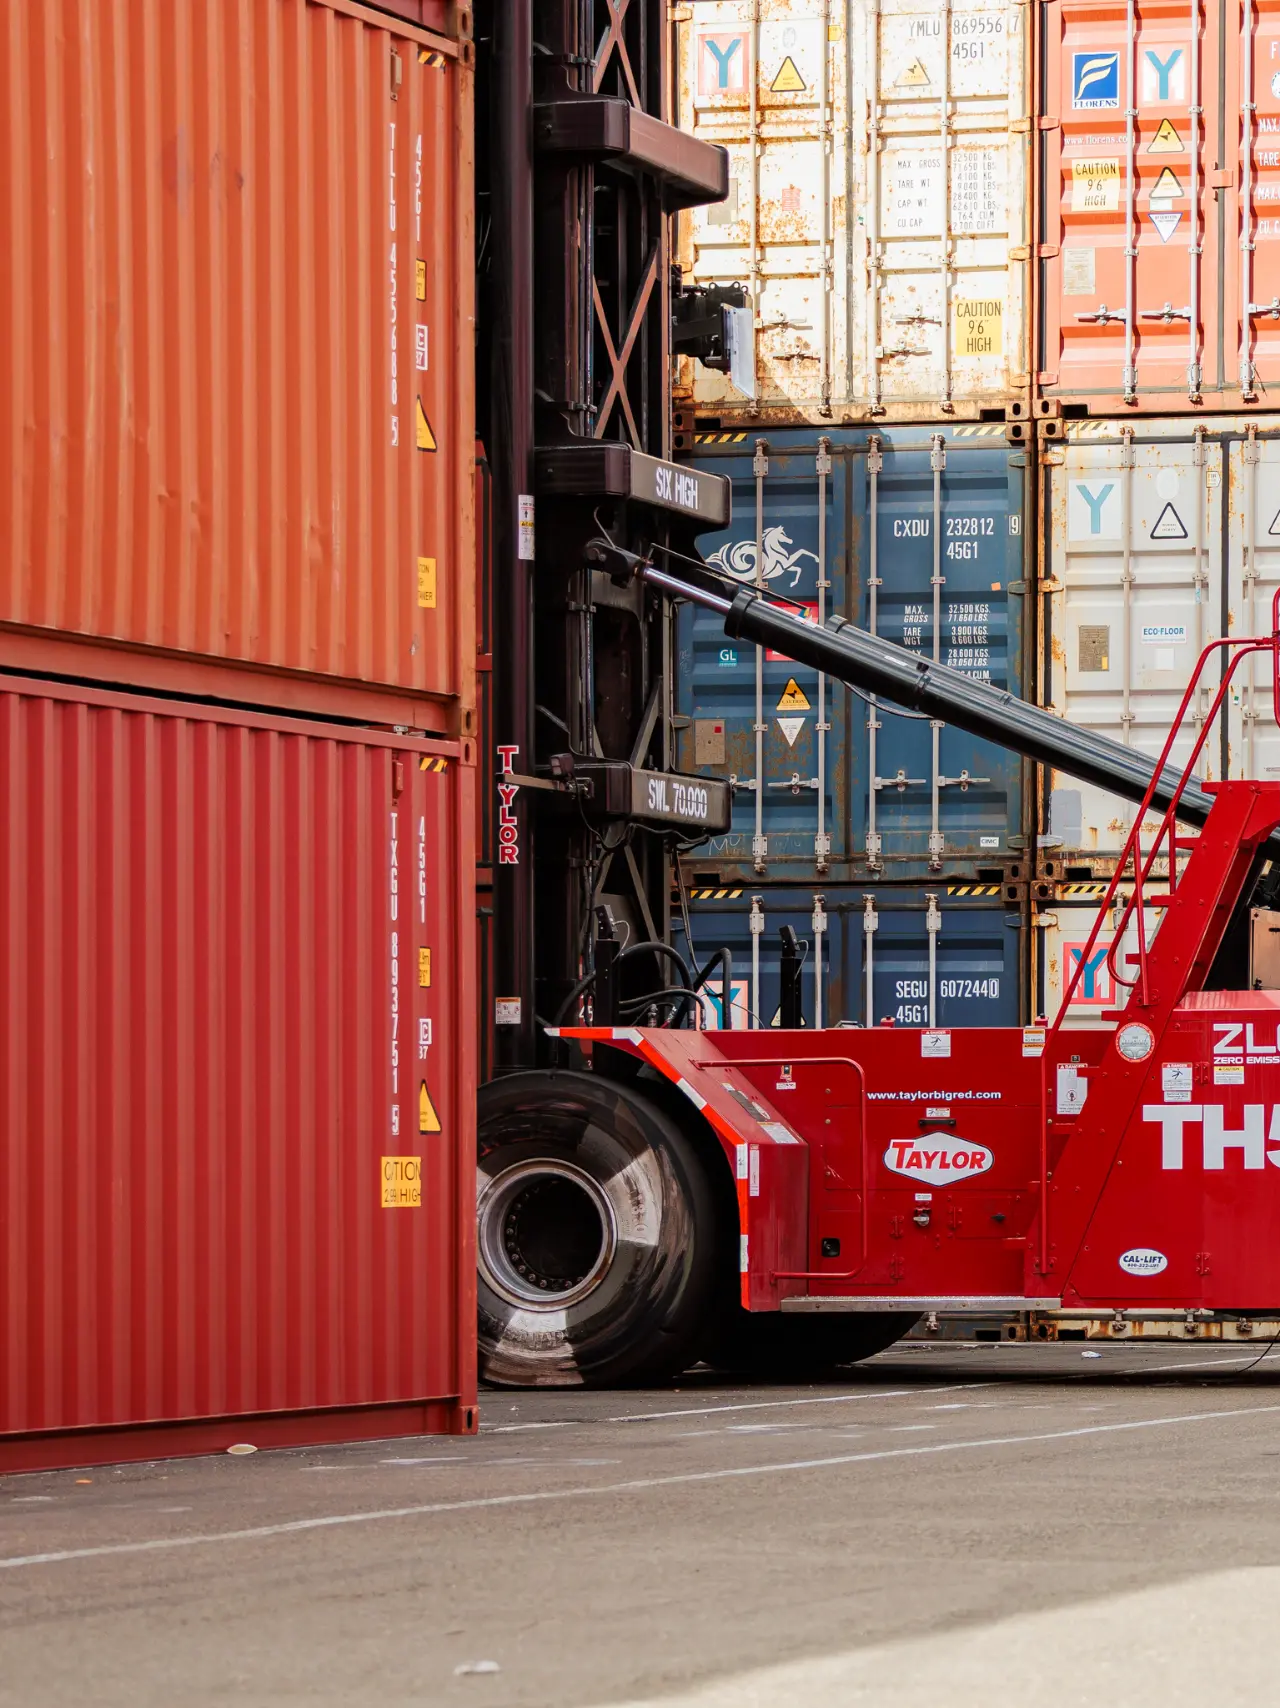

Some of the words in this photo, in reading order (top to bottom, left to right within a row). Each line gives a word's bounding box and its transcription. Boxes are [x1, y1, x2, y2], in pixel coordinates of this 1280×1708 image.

[909, 19, 941, 38] YMLU
[953, 16, 1003, 36] 869556
[1012, 15, 1019, 32] 7
[953, 42, 985, 60] 45G1
[1074, 99, 1118, 109] FLORENS
[983, 152, 993, 161] KG
[1258, 151, 1280, 167] TARE
[897, 160, 912, 169] MAX
[919, 158, 941, 169] GROSS
[1075, 162, 1117, 176] CAUTION
[983, 171, 993, 181] KG
[898, 179, 914, 188] TARE
[920, 178, 931, 188] WT
[983, 192, 993, 200] KG
[1084, 194, 1107, 206] HIGH
[897, 199, 912, 209] CAP
[917, 198, 928, 207] WT
[956, 301, 1001, 318] CAUTION
[966, 336, 992, 353] HIGH
[656, 466, 672, 501] SIX
[675, 472, 698, 510] HIGH
[894, 519, 930, 537] CXDU
[946, 517, 994, 536] 232812
[1010, 515, 1020, 535] 9
[946, 541, 979, 560] 45G1
[948, 604, 974, 614] 32.500
[903, 614, 929, 623] GROSS
[903, 627, 922, 636] TARE
[951, 626, 972, 636] 3.900
[719, 649, 737, 661] GL
[648, 778, 670, 812] SWL
[418, 816, 426, 923] 45G1
[896, 980, 928, 999] SEGU
[940, 980, 989, 998] 607244
[896, 1004, 929, 1024] 45G1
[1213, 1056, 1245, 1065] ZERO
[867, 1089, 1002, 1102] www.taylorbigred.com
[889, 1140, 986, 1170] TAYLOR
